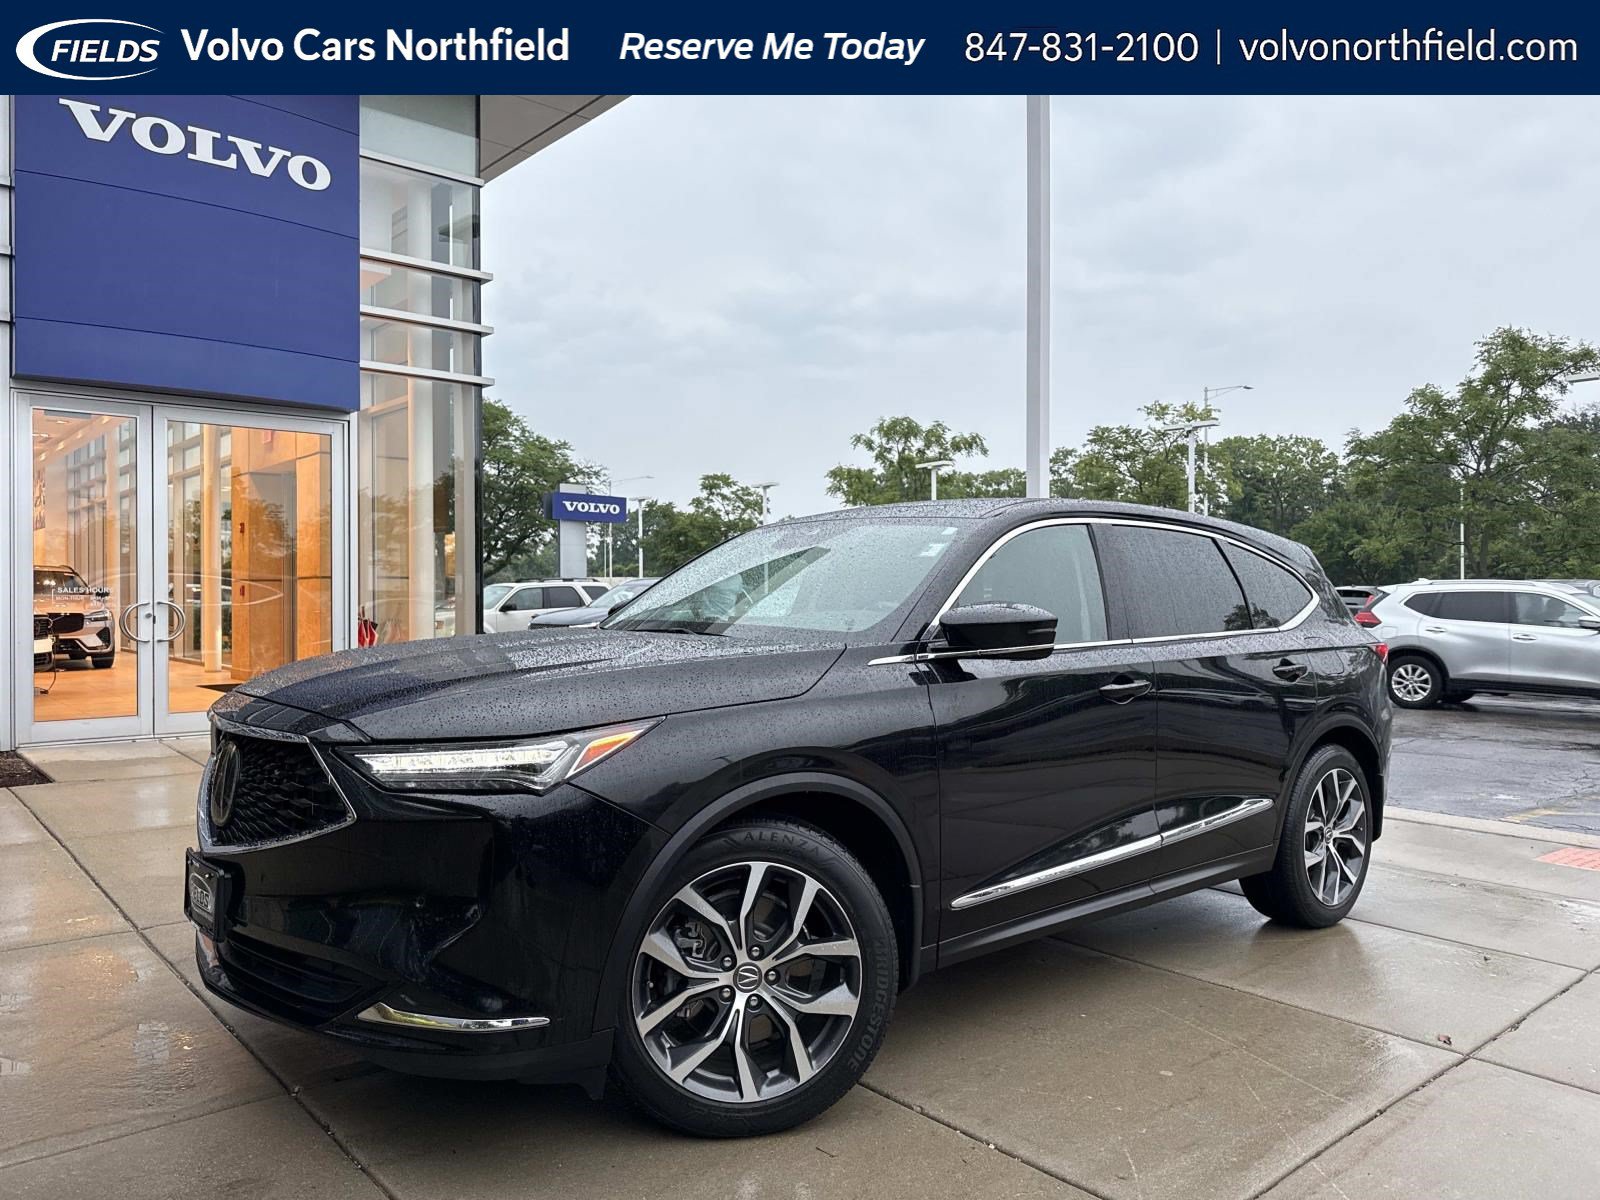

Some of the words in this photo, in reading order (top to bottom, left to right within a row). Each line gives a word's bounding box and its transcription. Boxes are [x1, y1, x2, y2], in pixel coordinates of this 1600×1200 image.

[58, 98, 332, 192] VOLVO
[562, 500, 621, 515] VOLVO
[57, 586, 84, 594] SALES
[743, 831, 820, 857] ALENZA
